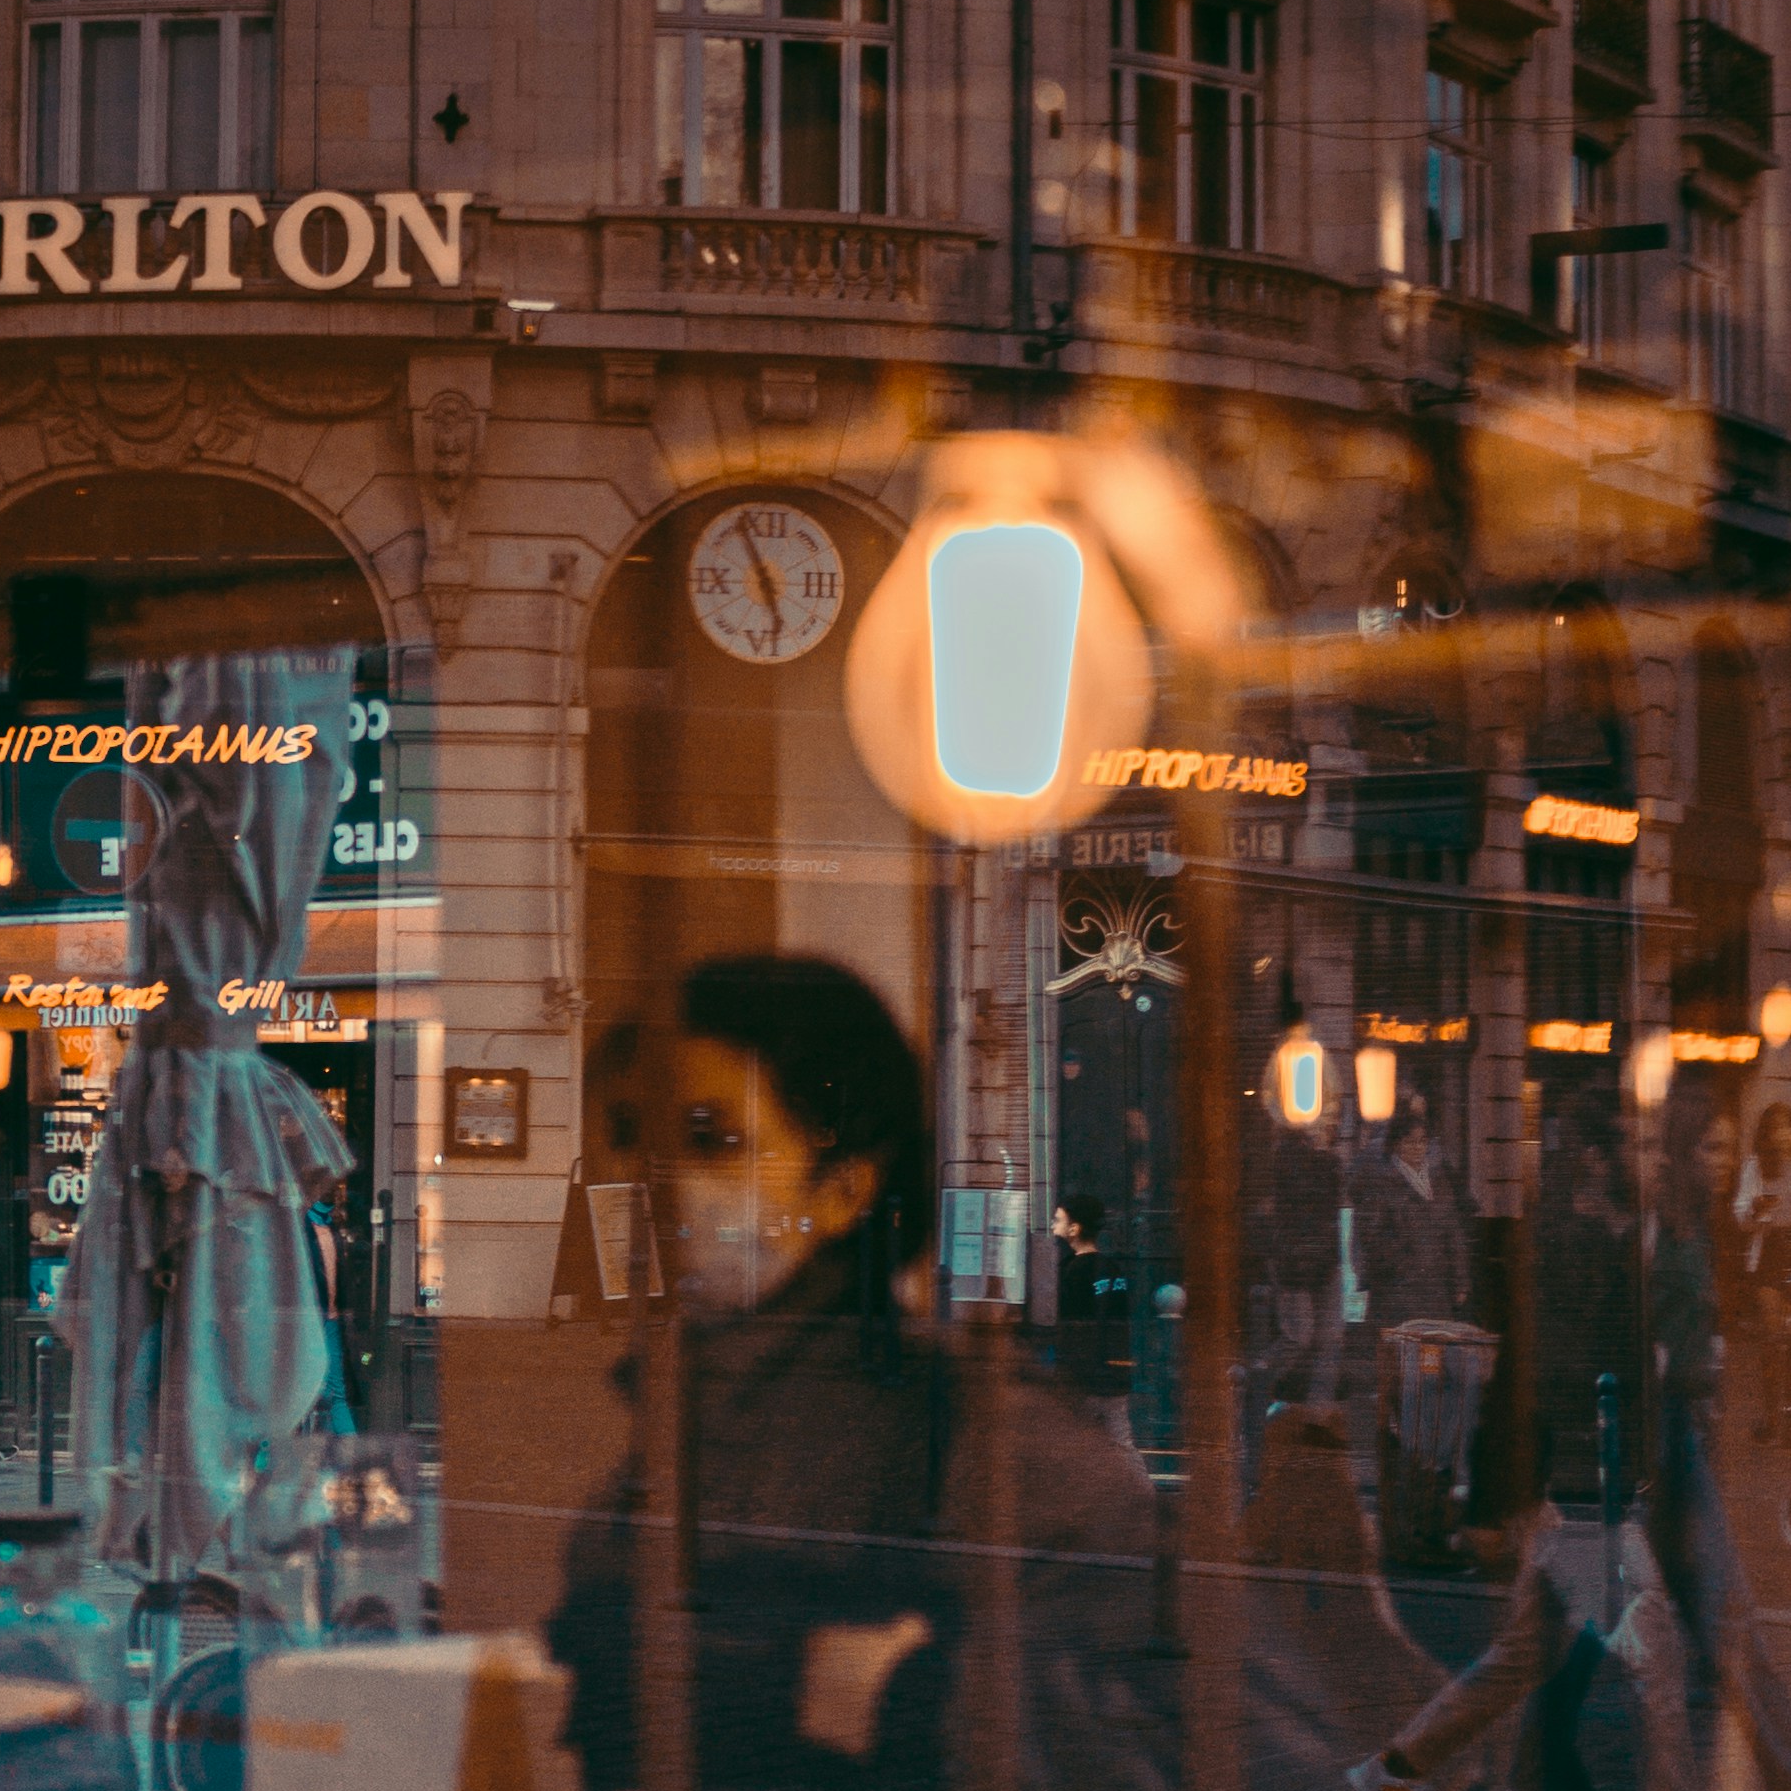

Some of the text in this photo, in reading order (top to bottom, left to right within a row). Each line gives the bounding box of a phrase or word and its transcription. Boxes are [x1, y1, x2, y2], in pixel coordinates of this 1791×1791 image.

[803, 572, 837, 598] III
[1080, 747, 1309, 797] HIPPOPOTAMUS
[217, 978, 286, 1015] Grill
